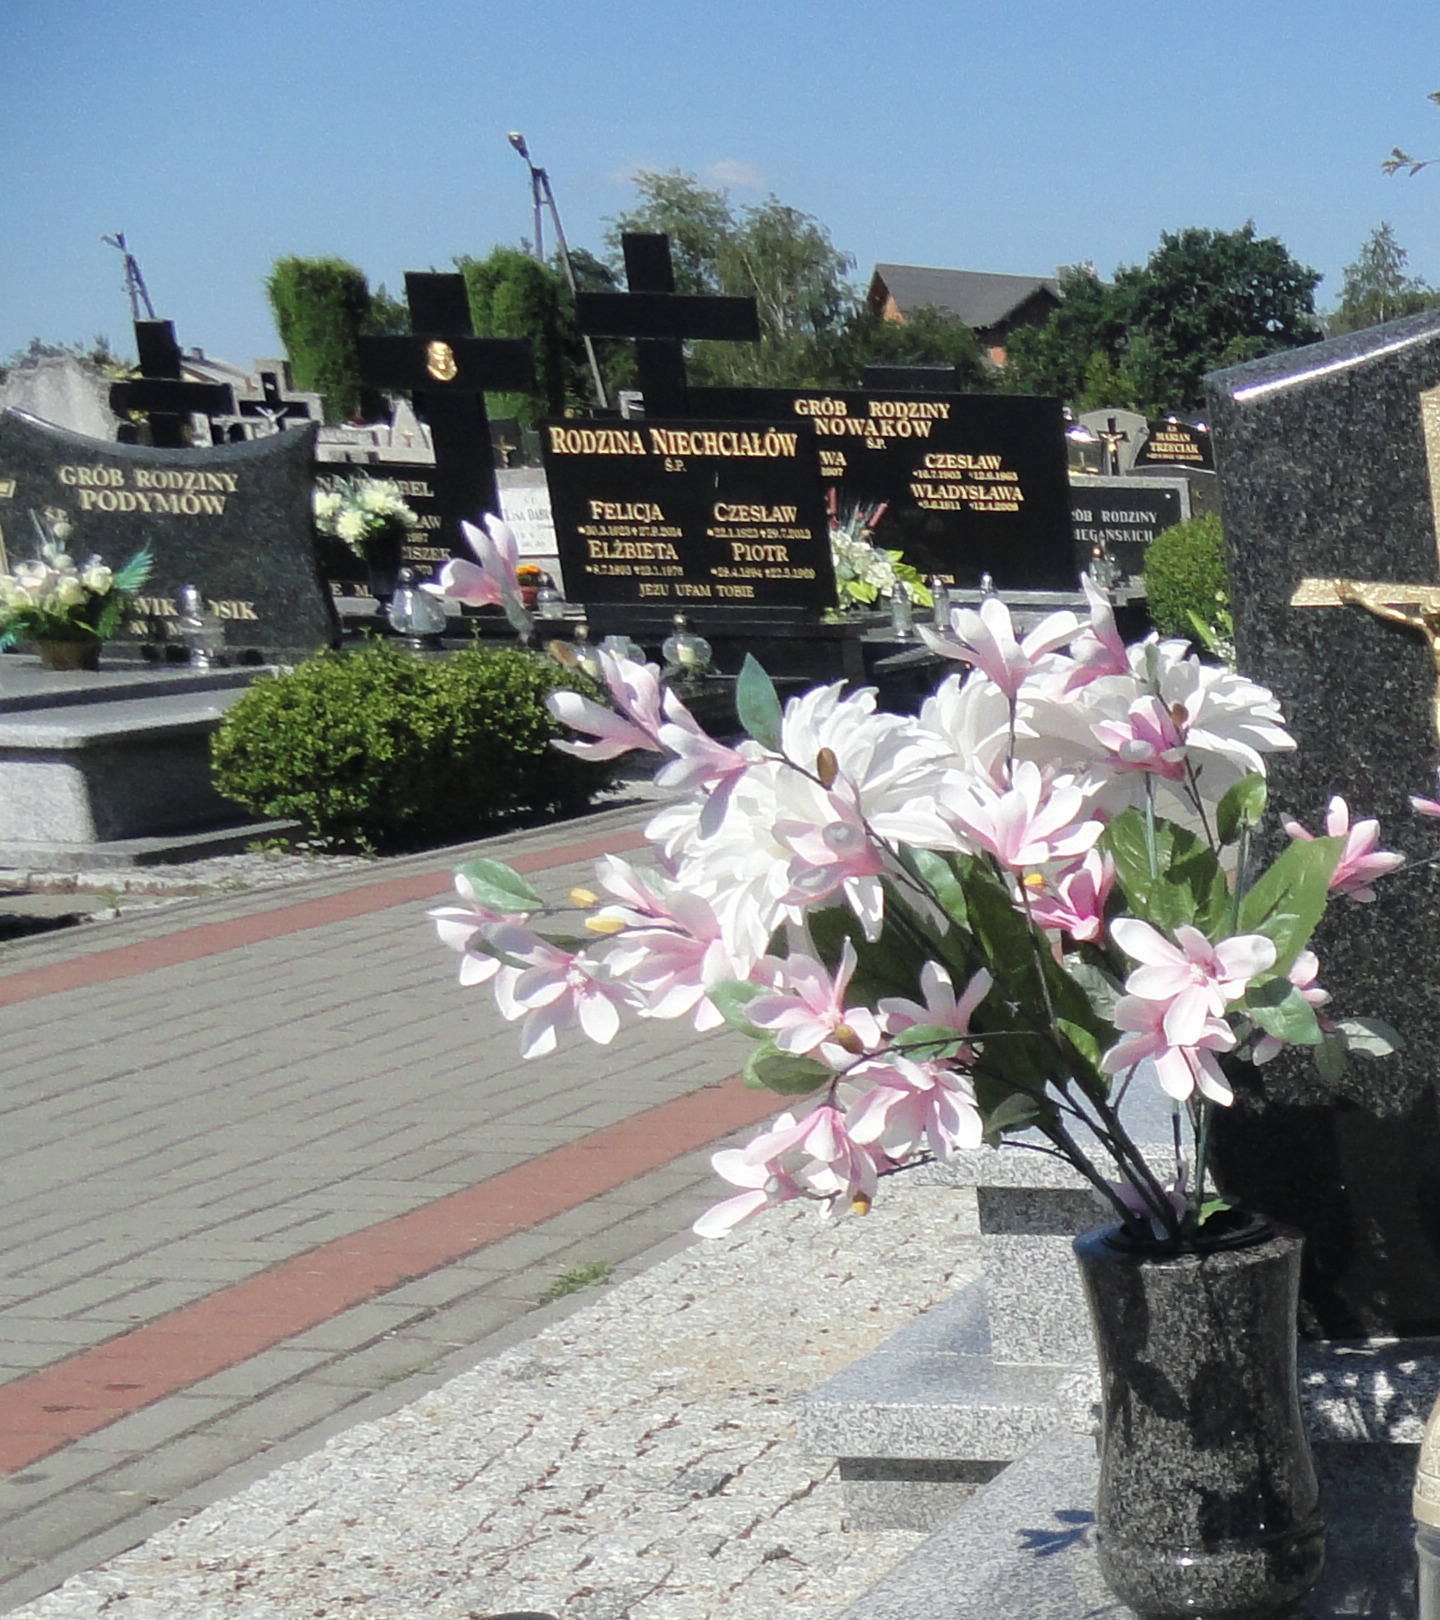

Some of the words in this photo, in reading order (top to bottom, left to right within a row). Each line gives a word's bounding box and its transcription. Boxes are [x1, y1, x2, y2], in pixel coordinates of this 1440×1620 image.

[794, 397, 848, 417] GRÓB
[869, 400, 950, 419] RODZINY
[813, 417, 932, 438] NOWAKÓW
[549, 426, 647, 455] RODZINA
[649, 427, 798, 457] NIECHCIAŁÓW
[59, 464, 125, 488] GRÓB
[133, 469, 239, 493] RODZINY
[78, 489, 227, 515] PODYMÓW
[590, 500, 665, 523] FELICJA
[1101, 510, 1157, 524] RODZINY
[587, 538, 679, 560] ELŻBIETA
[731, 542, 790, 562] PIOTR
[675, 583, 711, 597] UFAM
